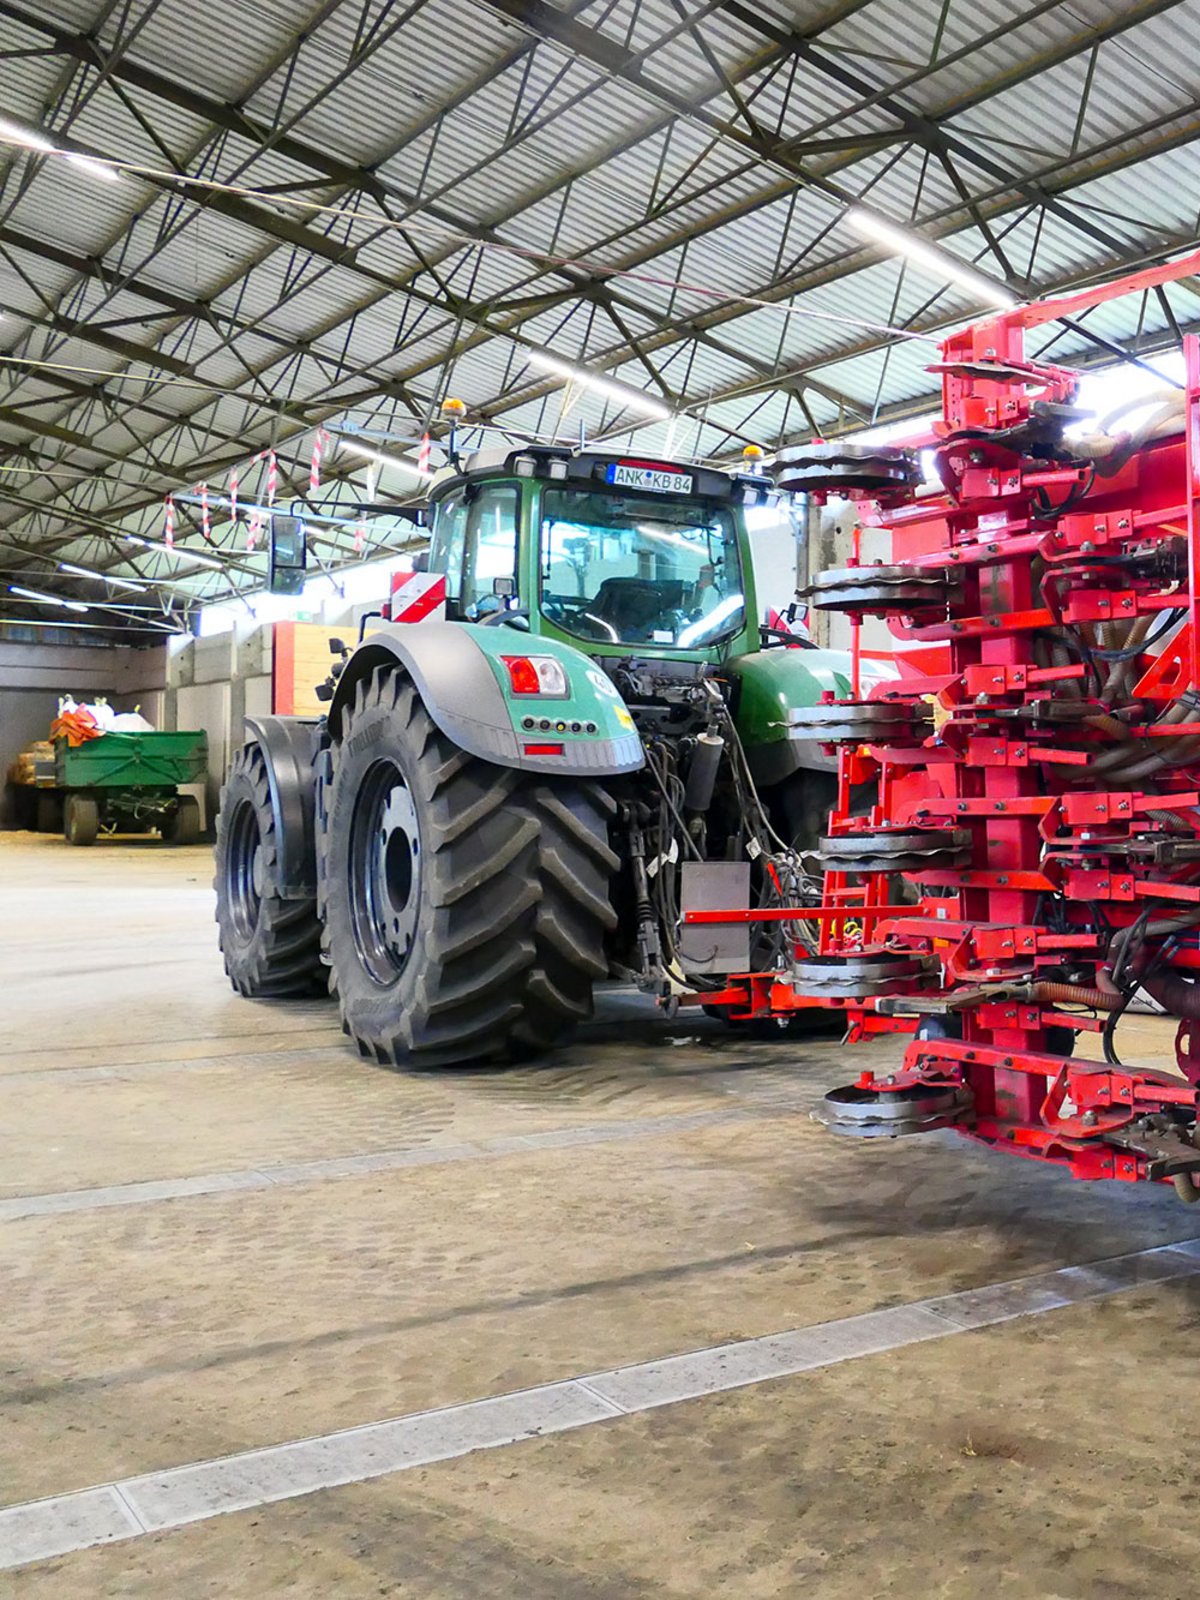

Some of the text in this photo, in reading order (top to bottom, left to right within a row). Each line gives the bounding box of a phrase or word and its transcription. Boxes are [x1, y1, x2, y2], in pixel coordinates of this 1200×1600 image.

[616, 469, 690, 492] ANK KB 84
